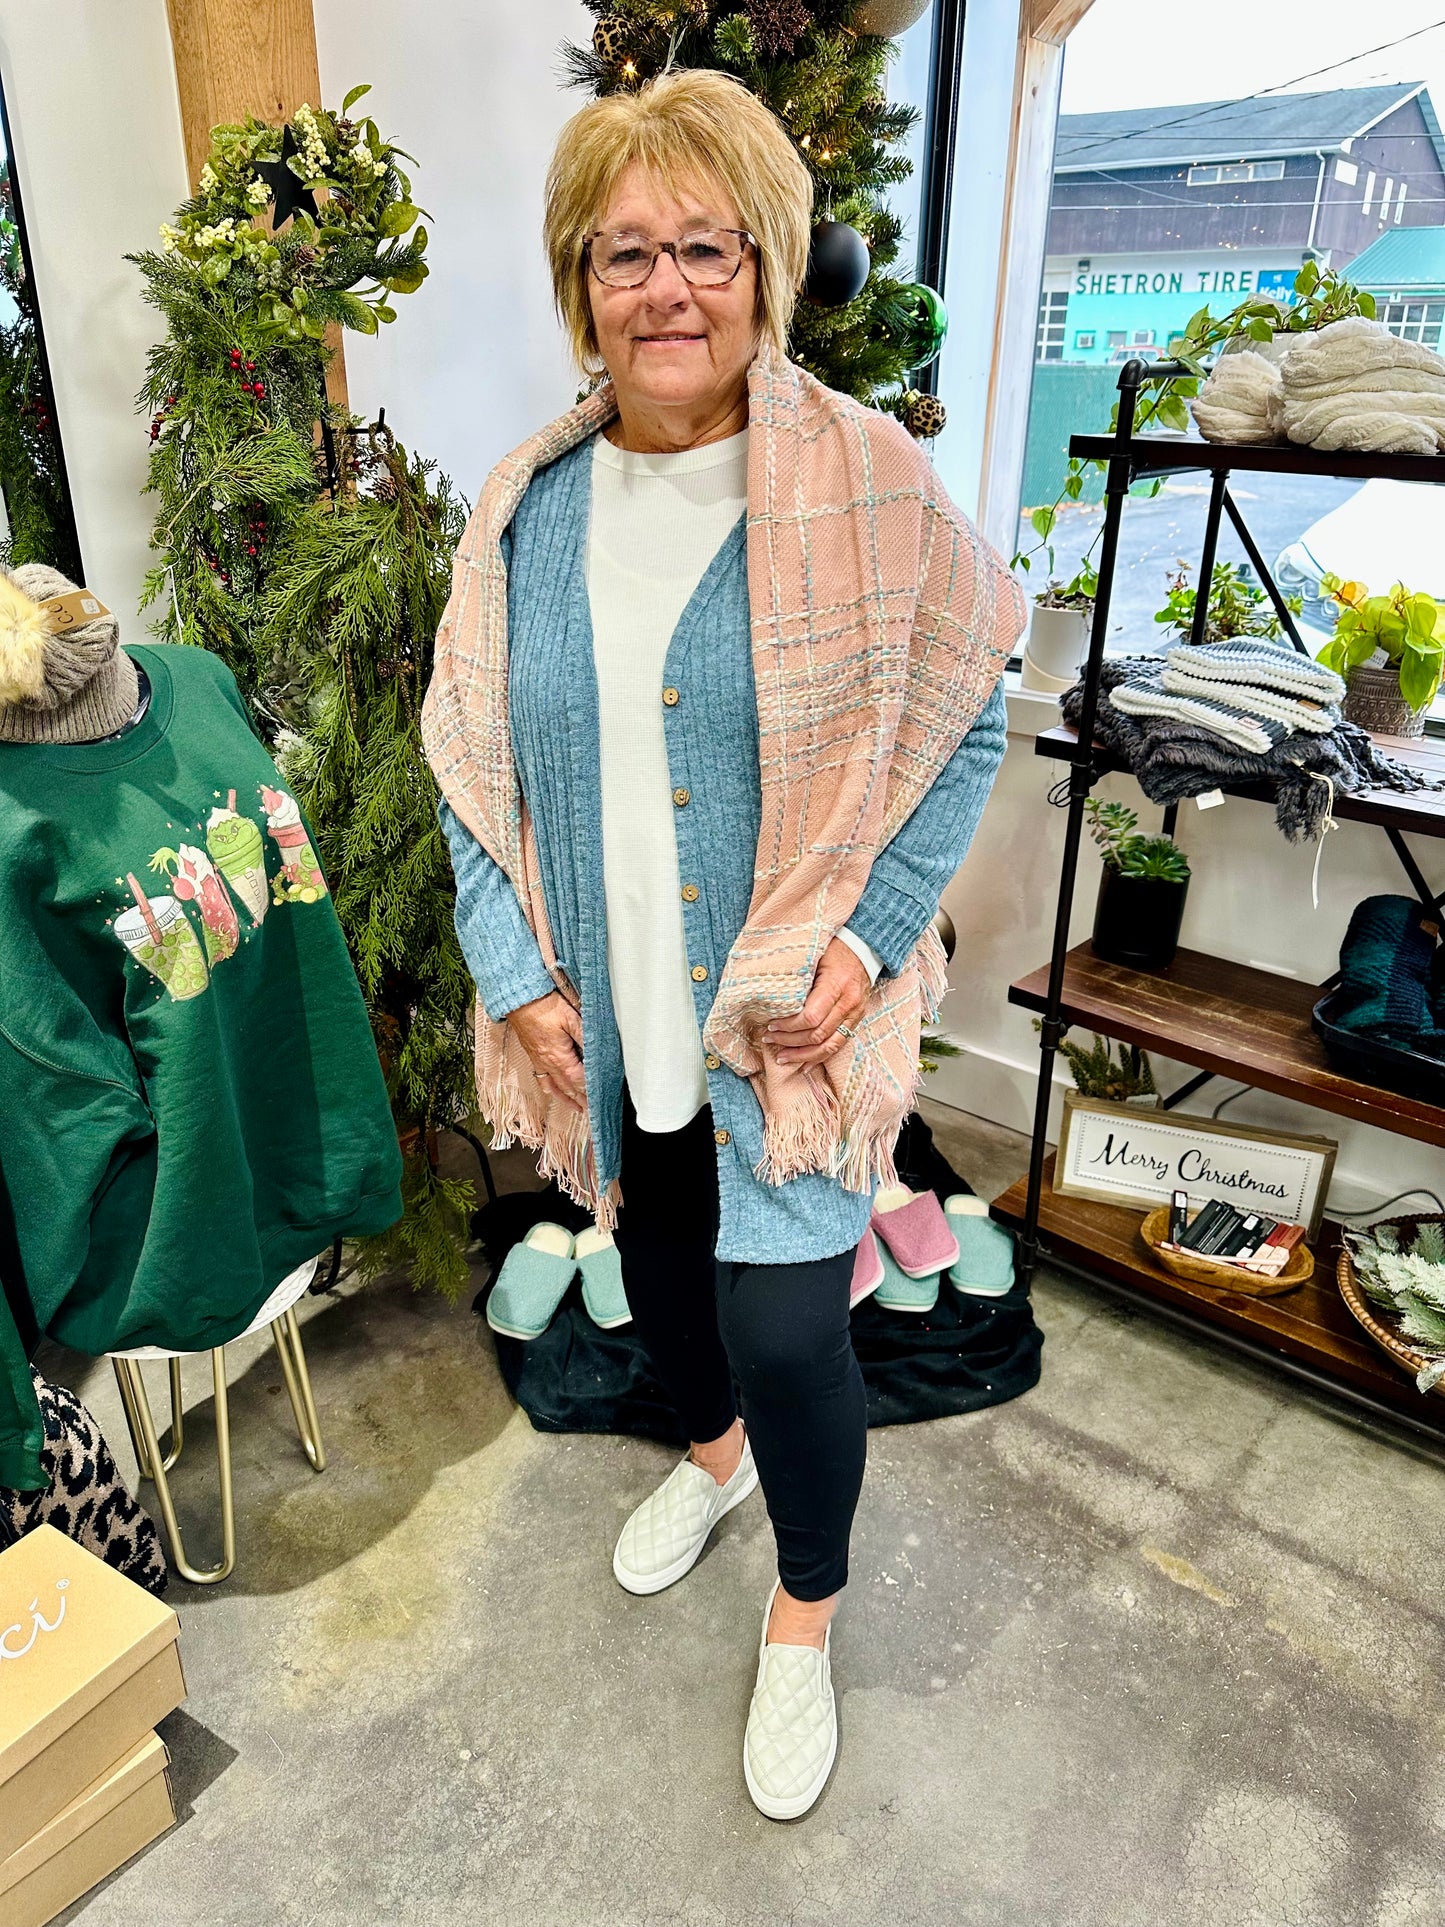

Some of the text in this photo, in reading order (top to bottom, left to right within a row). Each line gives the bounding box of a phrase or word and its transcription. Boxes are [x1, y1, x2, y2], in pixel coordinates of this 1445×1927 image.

[1076, 270, 1253, 295] SHETRON TIRE
[1090, 1134, 1289, 1198] Merry Christmas
